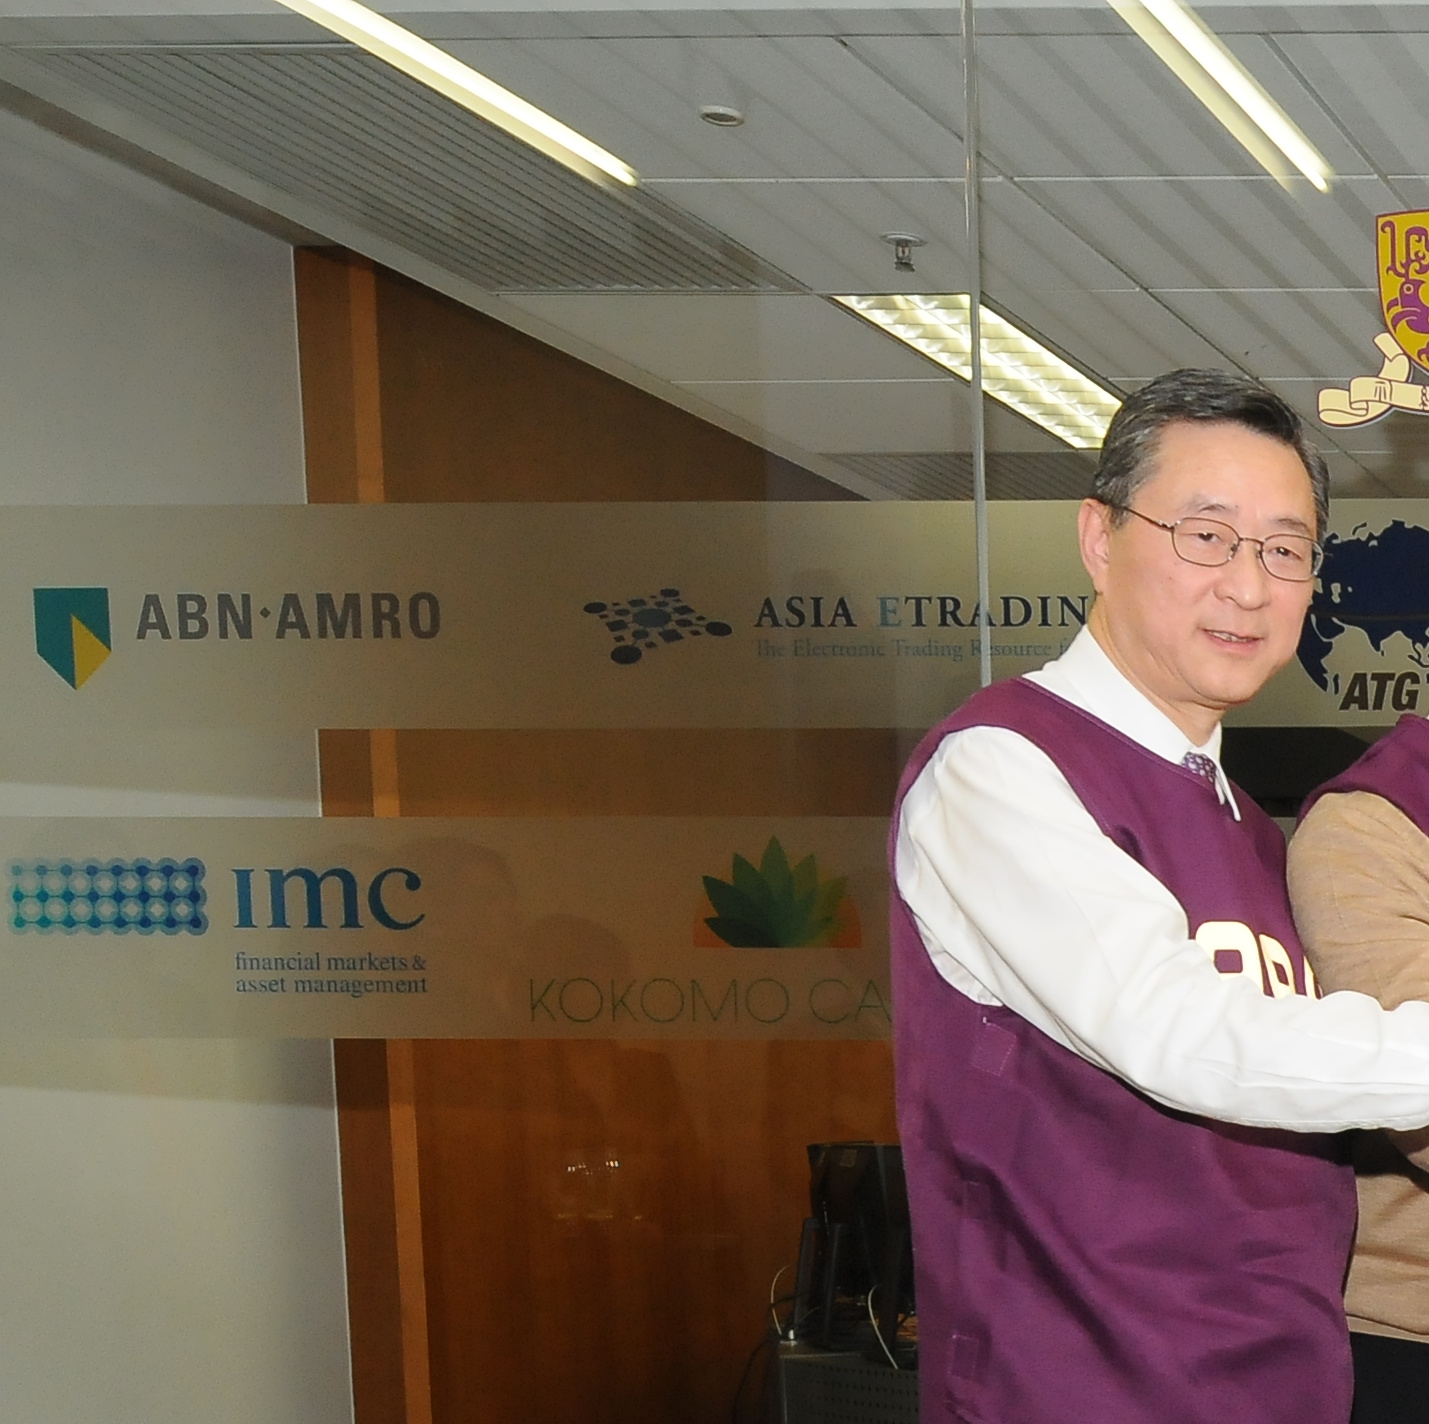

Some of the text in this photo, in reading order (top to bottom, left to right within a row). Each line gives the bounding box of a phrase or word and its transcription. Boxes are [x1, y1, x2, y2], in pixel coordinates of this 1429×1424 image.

[754, 596, 857, 627] ASIA
[756, 640, 784, 657] The
[794, 640, 884, 657] Electronic
[894, 639, 962, 660] Trading
[1339, 671, 1420, 711] ATG
[235, 952, 427, 971] financial markets &
[236, 977, 428, 998] asset management
[529, 977, 789, 1024] KOKOMO
